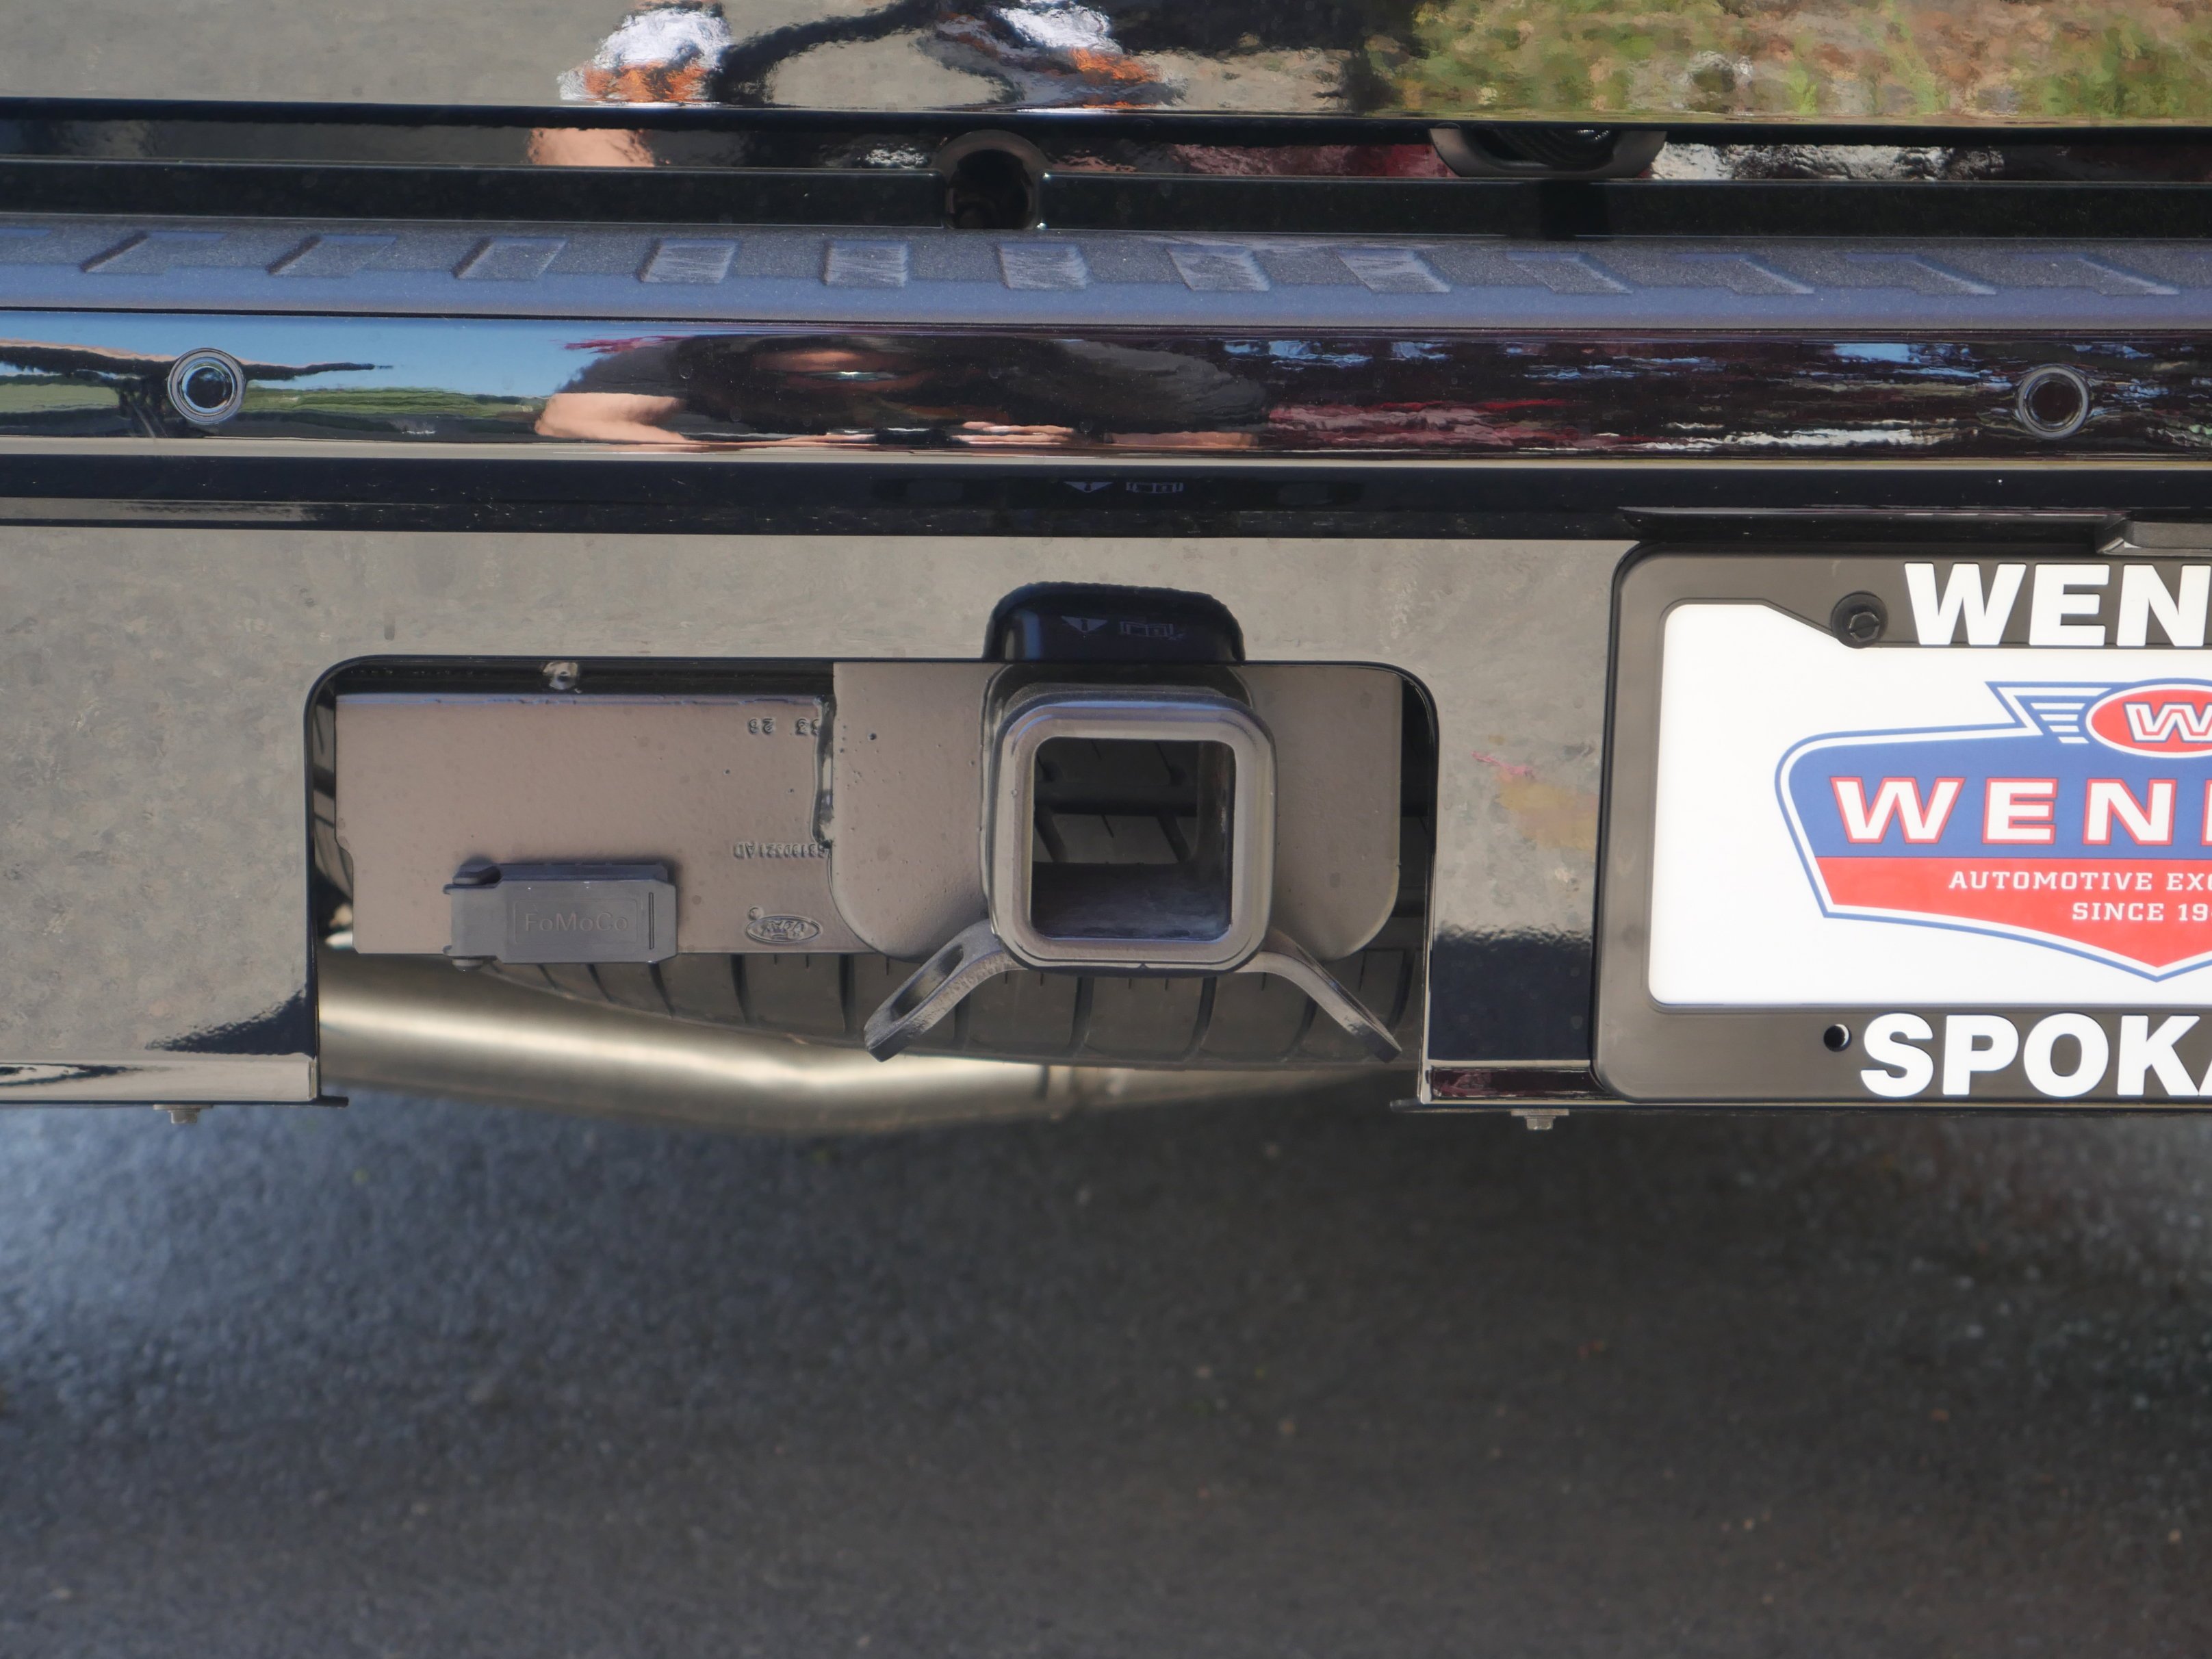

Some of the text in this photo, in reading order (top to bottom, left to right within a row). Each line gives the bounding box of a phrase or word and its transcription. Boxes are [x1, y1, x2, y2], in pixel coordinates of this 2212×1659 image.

[1829, 776, 2212, 846] WEN
[1949, 870, 2212, 891] AUTOMOTIVE EX
[524, 912, 628, 932] FoMoCo
[2072, 902, 2212, 922] SINCE 19
[1860, 1013, 2212, 1097] SPOK
